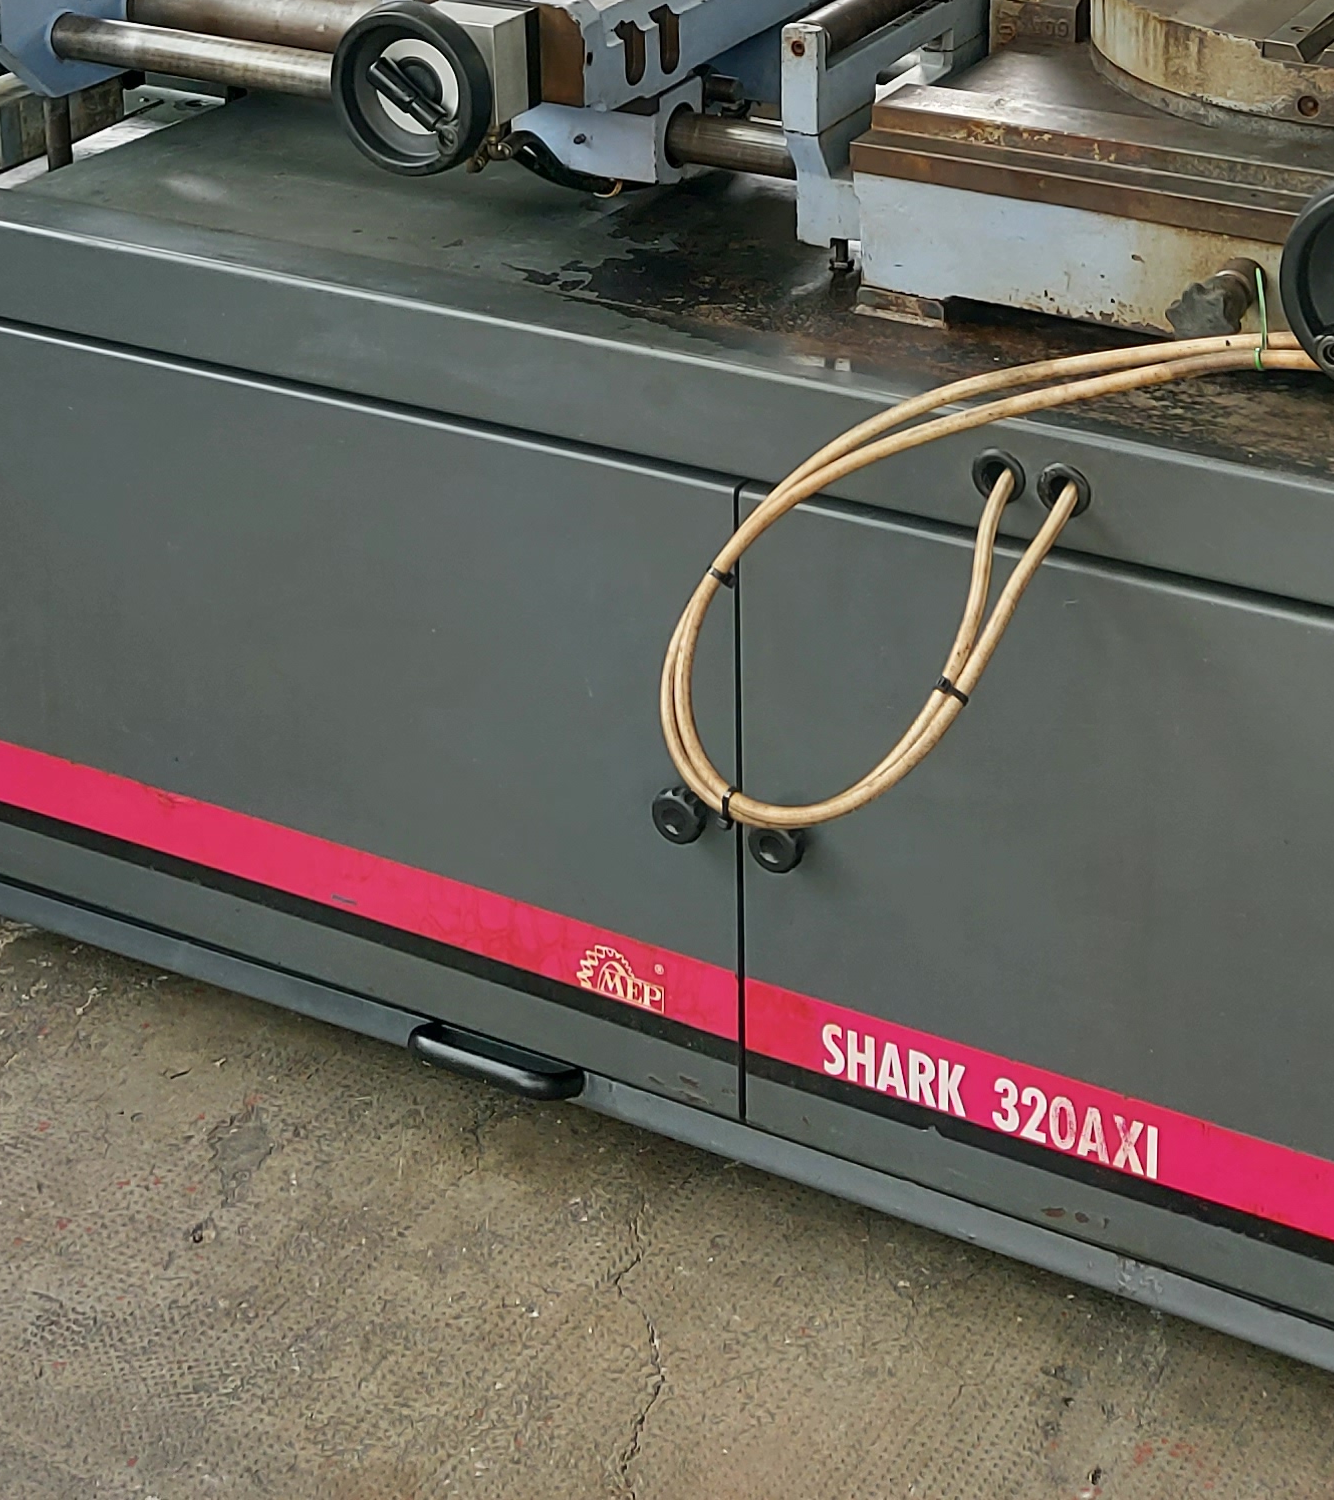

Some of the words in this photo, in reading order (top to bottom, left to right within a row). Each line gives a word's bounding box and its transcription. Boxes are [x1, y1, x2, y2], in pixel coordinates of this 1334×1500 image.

[599, 967, 663, 1009] MEP
[822, 1023, 966, 1118] SHARK
[992, 1078, 1159, 1180] 320AXI
